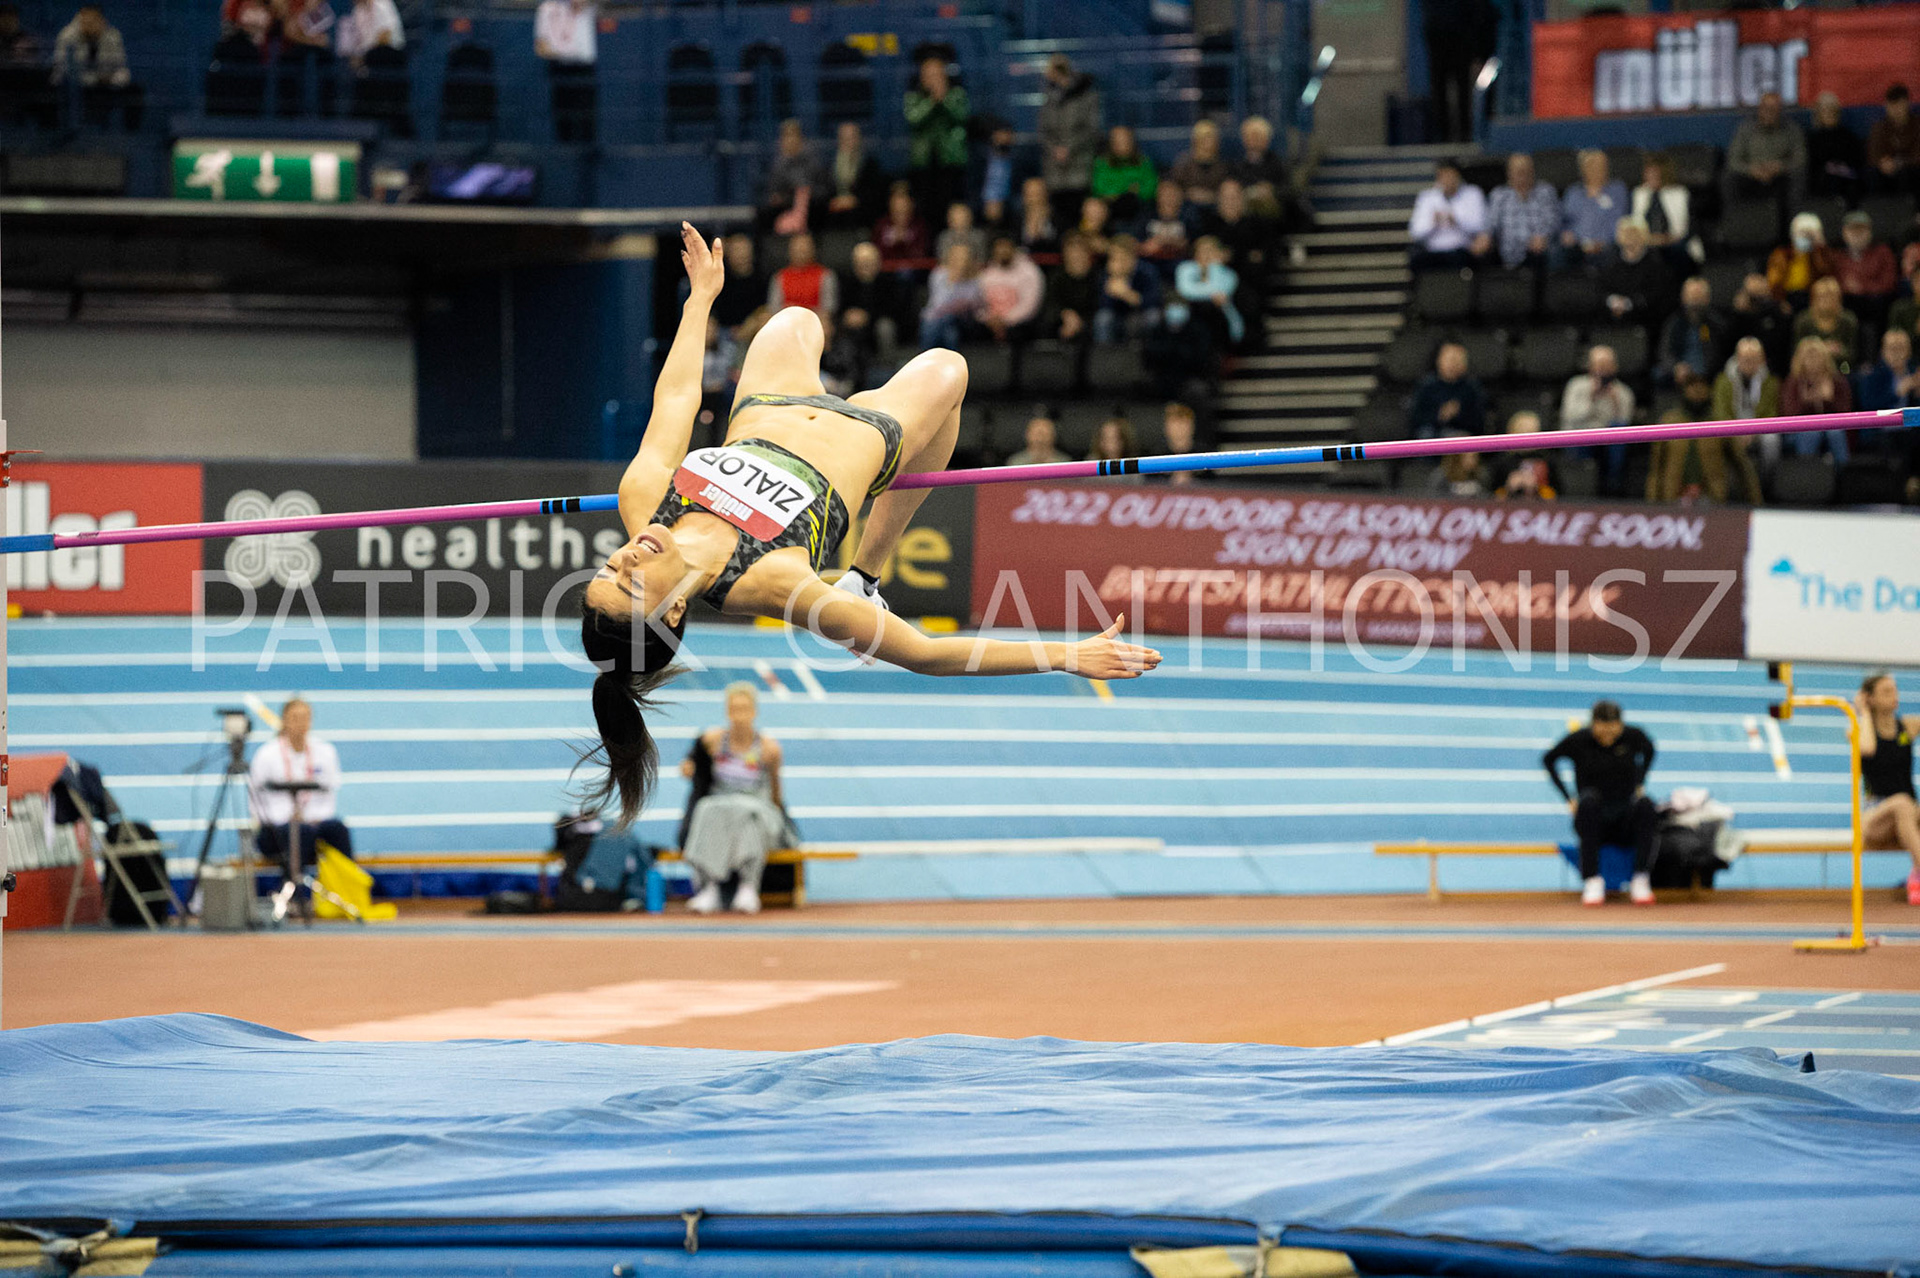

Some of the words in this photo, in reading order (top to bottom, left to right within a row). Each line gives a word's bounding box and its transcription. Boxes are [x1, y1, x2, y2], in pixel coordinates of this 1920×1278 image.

[698, 483, 754, 522] müller
[699, 451, 804, 513] ZIALOR
[1012, 489, 1108, 525] 2022
[1110, 492, 1294, 531] OUTDOOR
[1294, 501, 1440, 539] SEASON
[1440, 507, 1503, 543] ON
[1502, 509, 1597, 545] SALE
[1217, 532, 1312, 566] SIGN
[1313, 535, 1374, 568] UP
[1373, 538, 1473, 573] NOW
[1797, 573, 1863, 613] The
